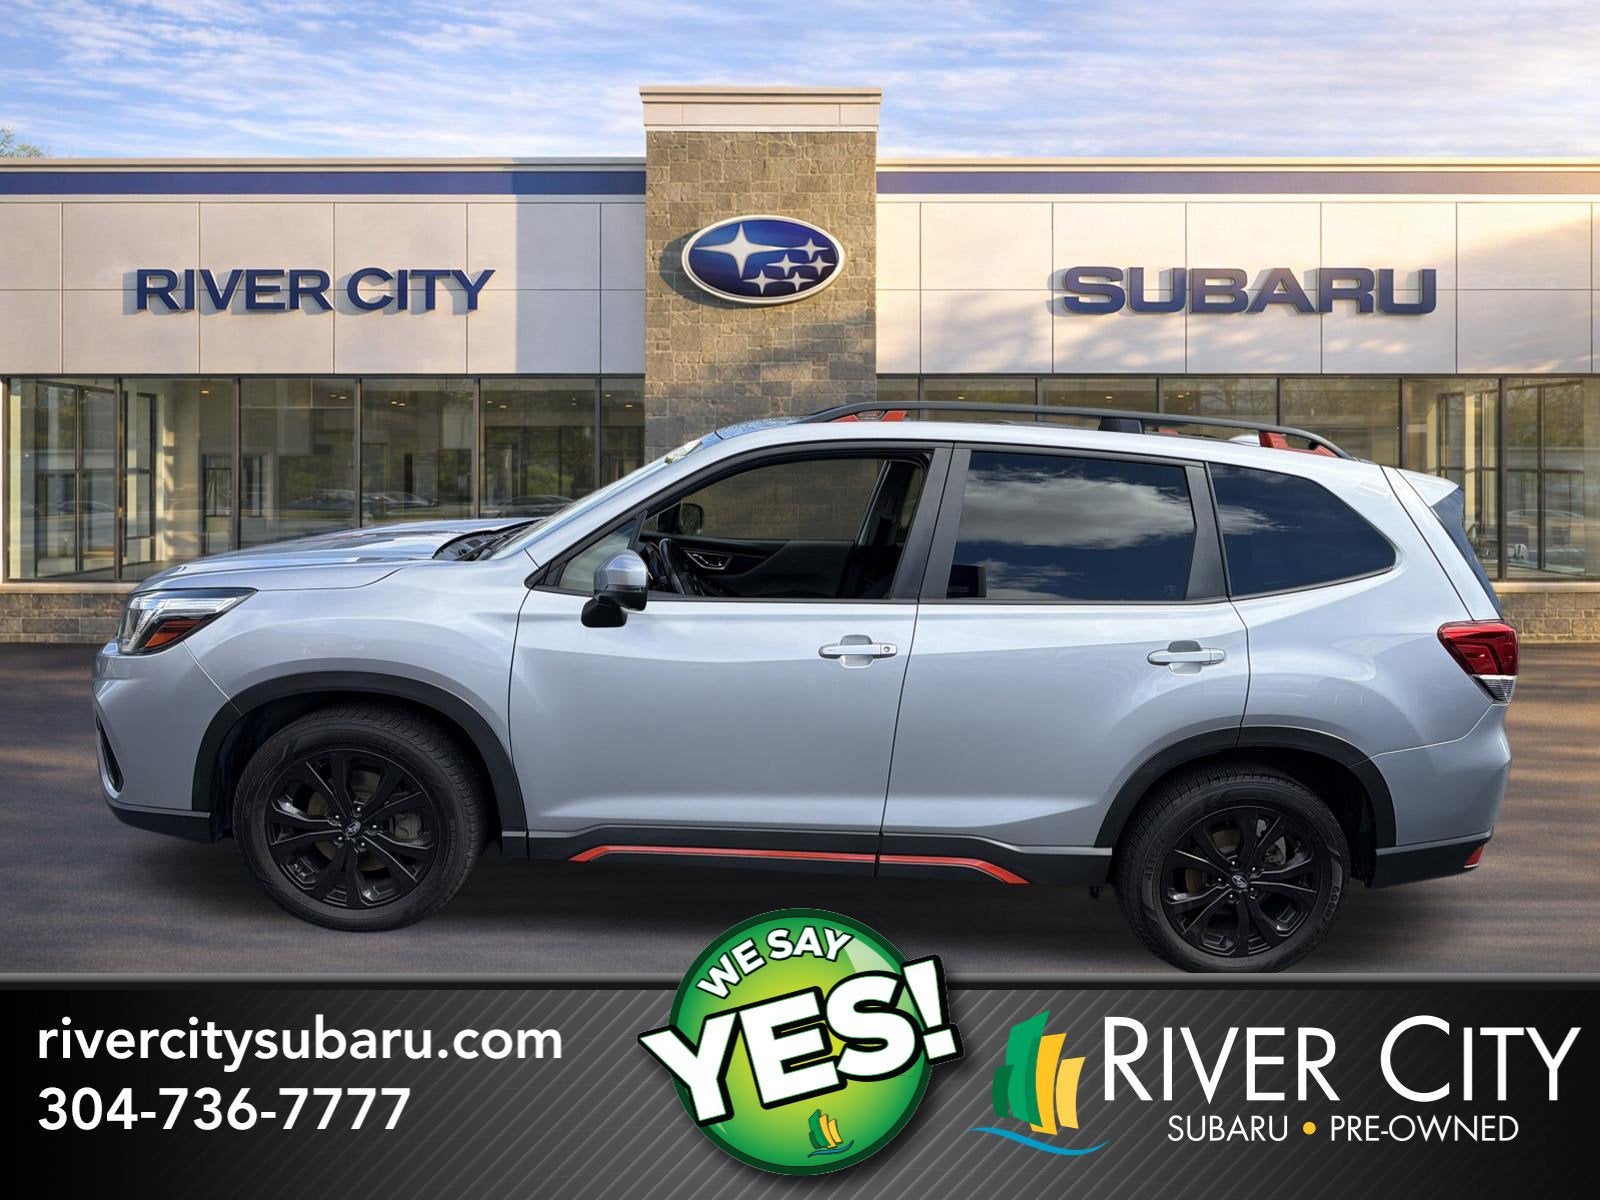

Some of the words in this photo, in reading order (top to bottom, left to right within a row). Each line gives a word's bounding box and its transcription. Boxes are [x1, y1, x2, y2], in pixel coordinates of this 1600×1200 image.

[136, 269, 334, 311] RIVER
[346, 267, 496, 312] CITY
[1063, 266, 1437, 314] SUBARU
